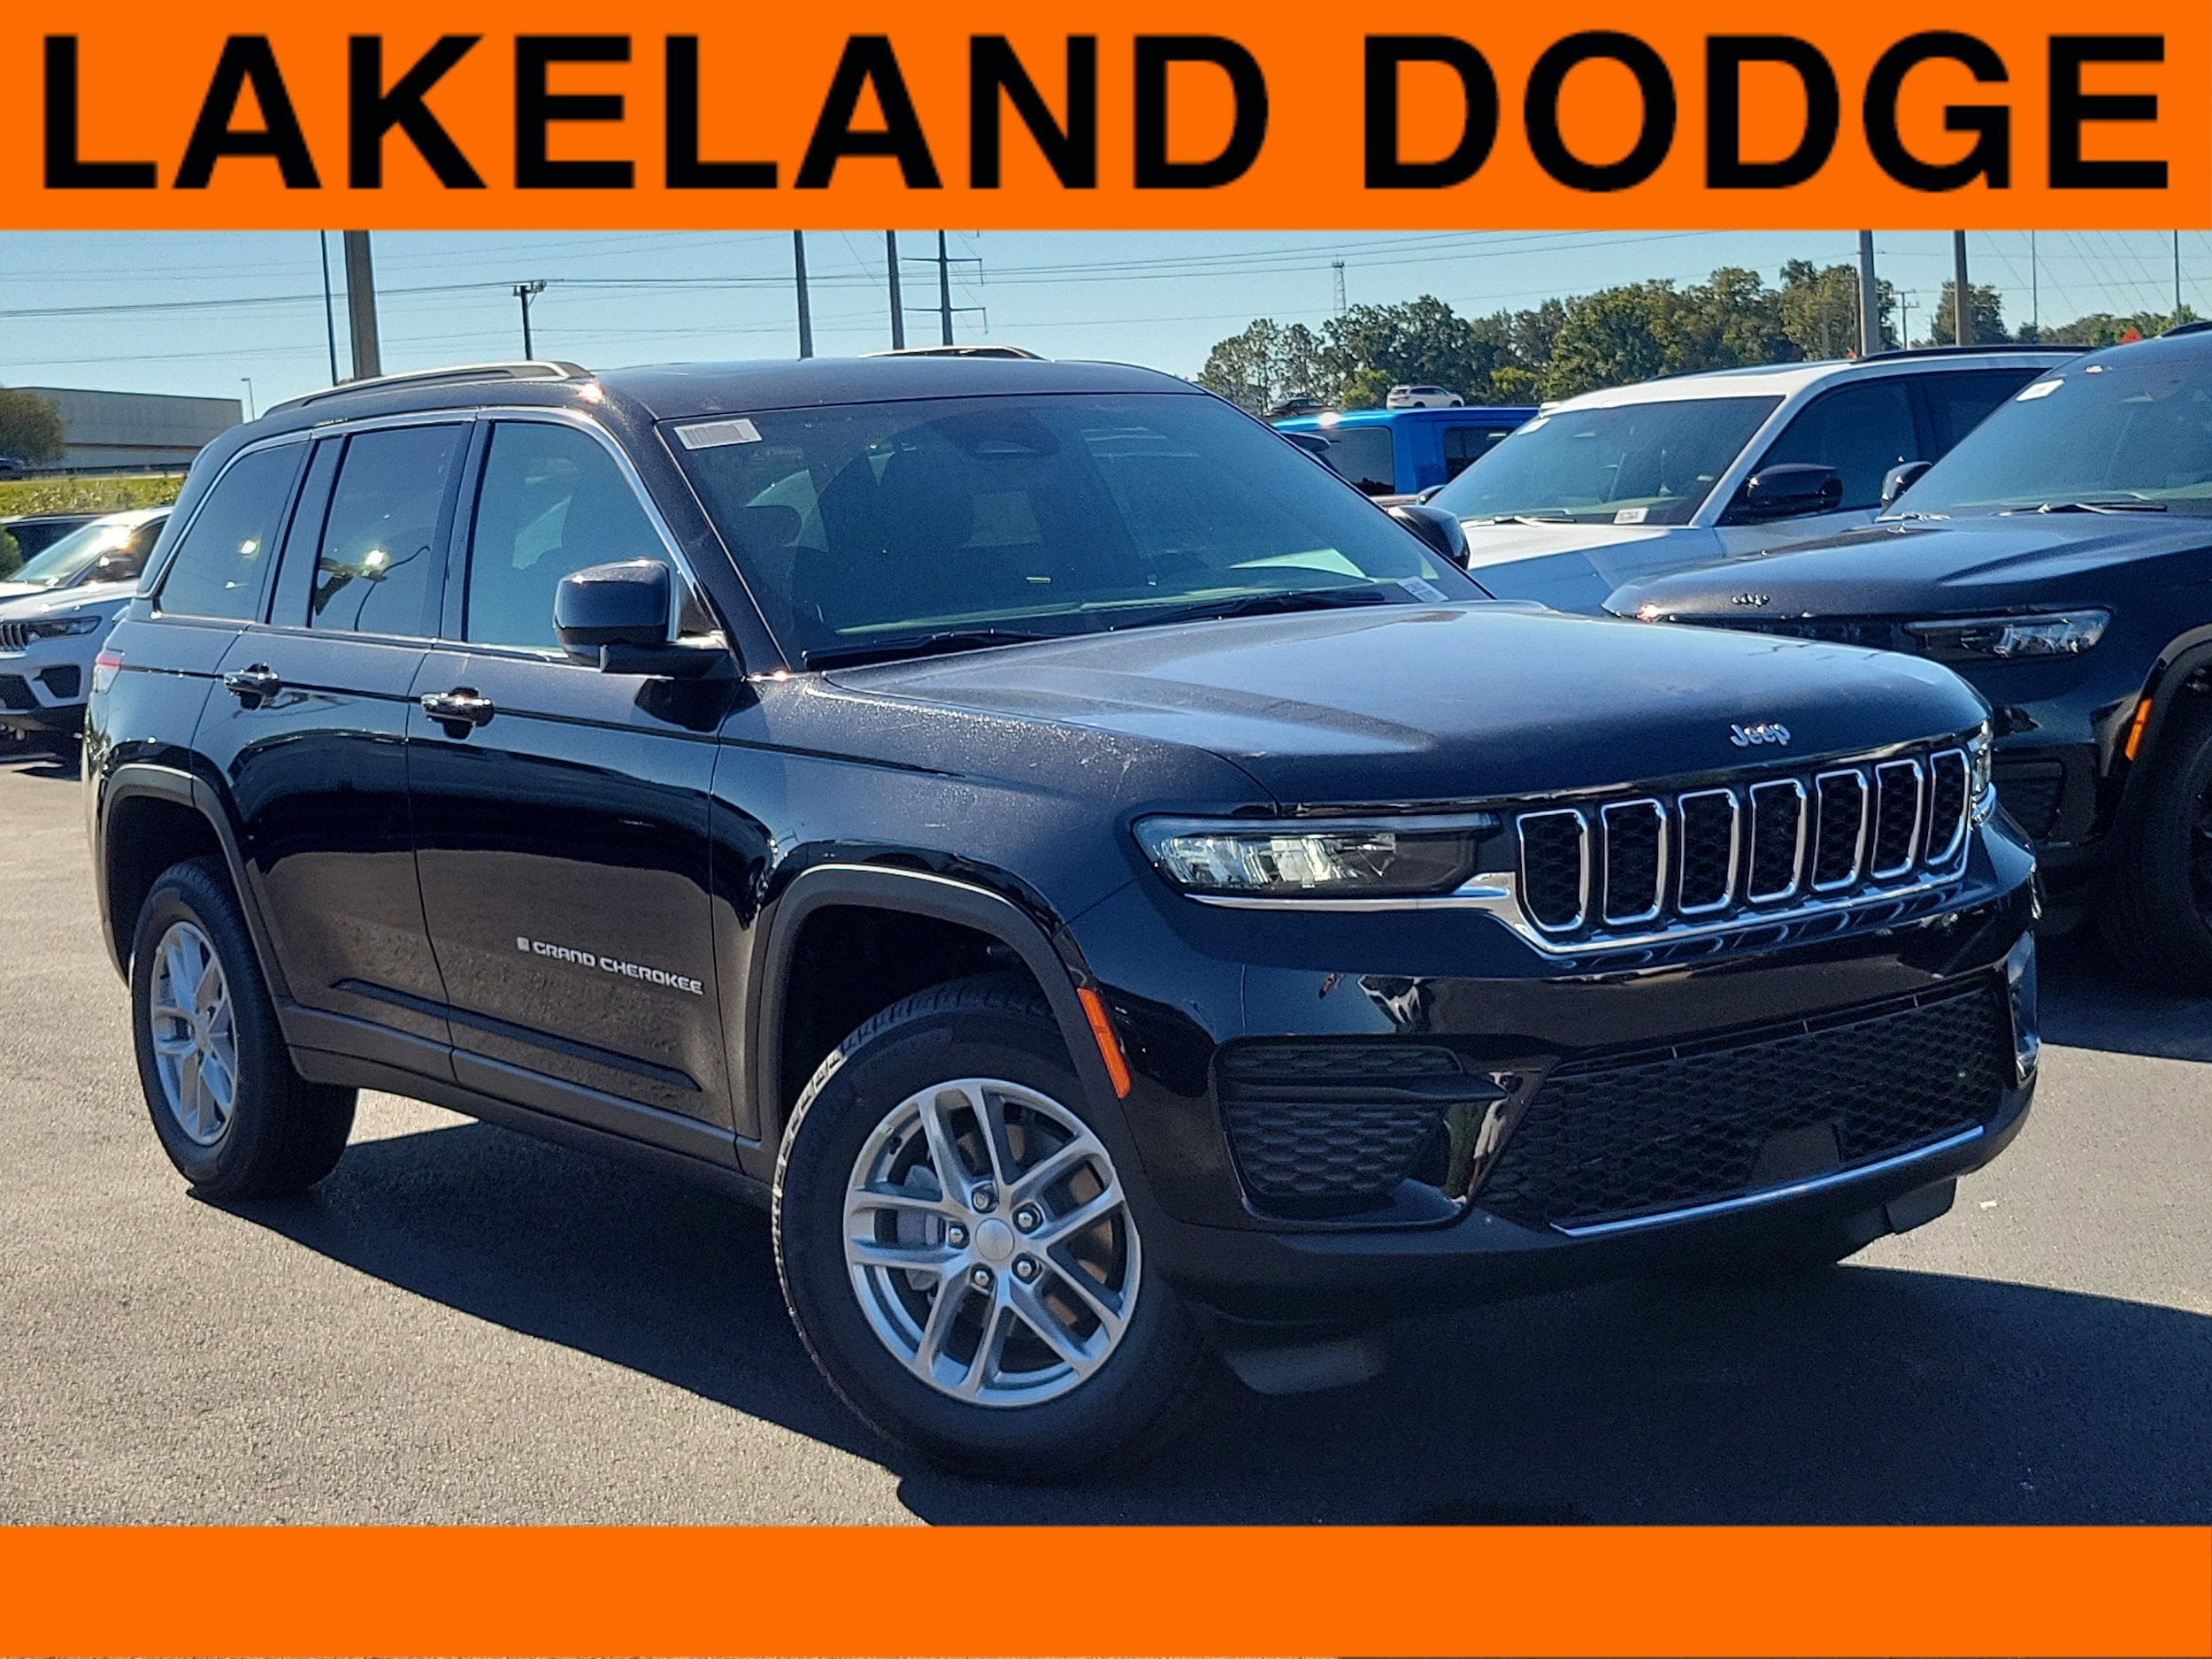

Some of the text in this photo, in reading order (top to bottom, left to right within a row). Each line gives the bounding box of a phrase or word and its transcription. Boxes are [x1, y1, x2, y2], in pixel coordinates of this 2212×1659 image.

[1730, 724, 1791, 747] Jeep
[533, 941, 704, 996] GRAND CHEROKEE
